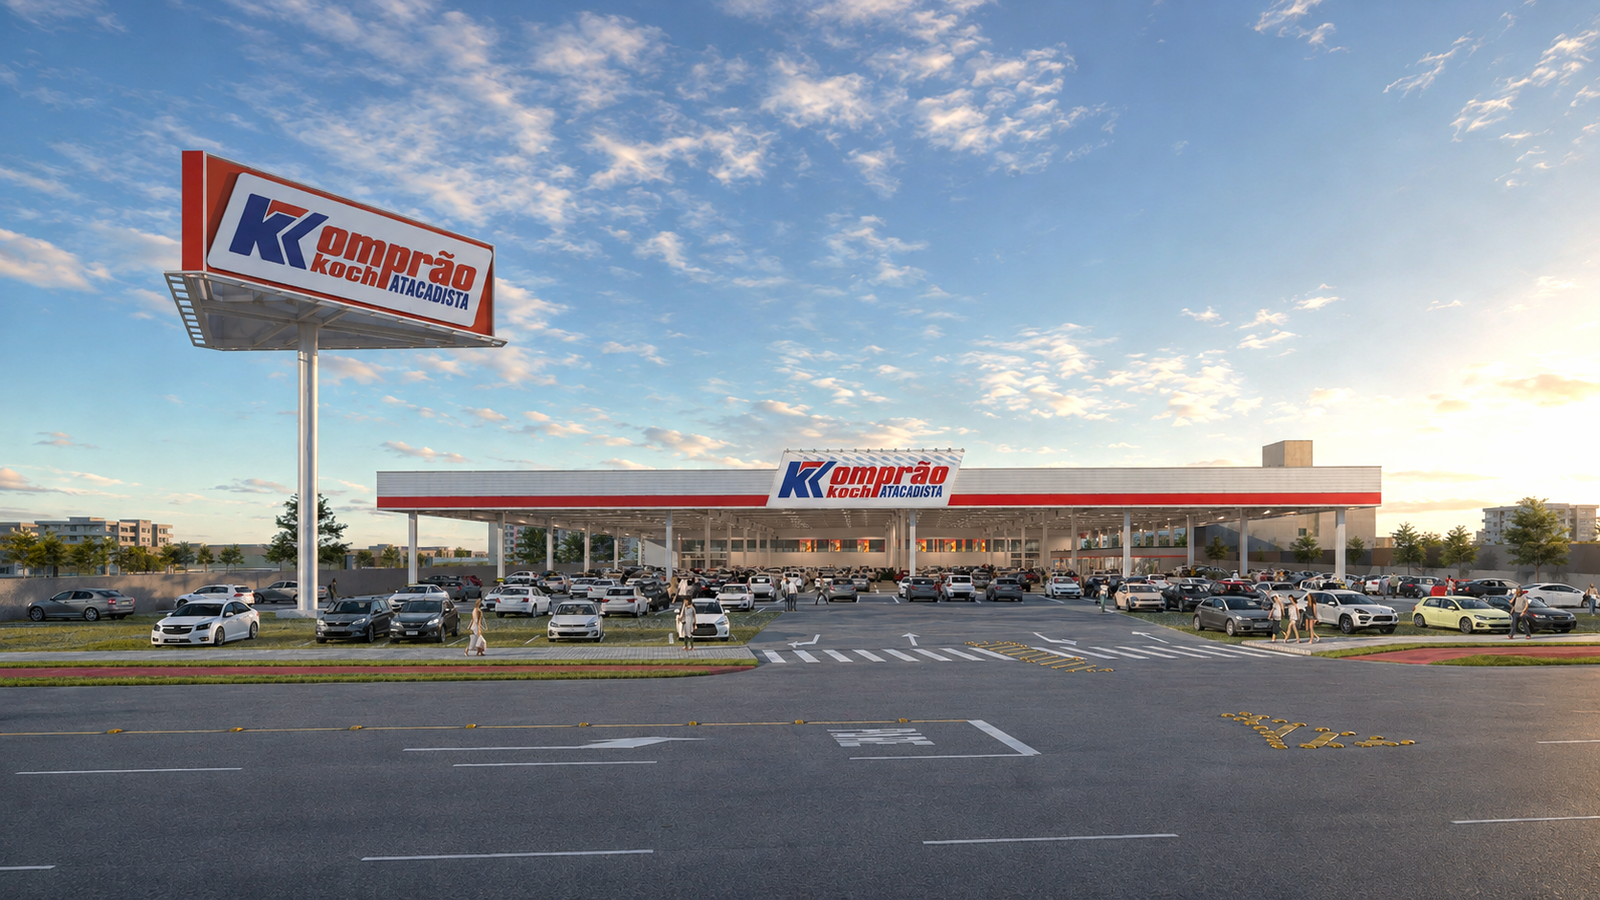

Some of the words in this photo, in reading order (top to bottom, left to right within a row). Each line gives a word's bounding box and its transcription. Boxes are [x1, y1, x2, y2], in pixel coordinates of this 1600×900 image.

[310, 253, 378, 287] koch
[388, 274, 469, 311] ATACADISTA
[826, 485, 871, 498] koch
[879, 485, 943, 498] ATACADISTA
